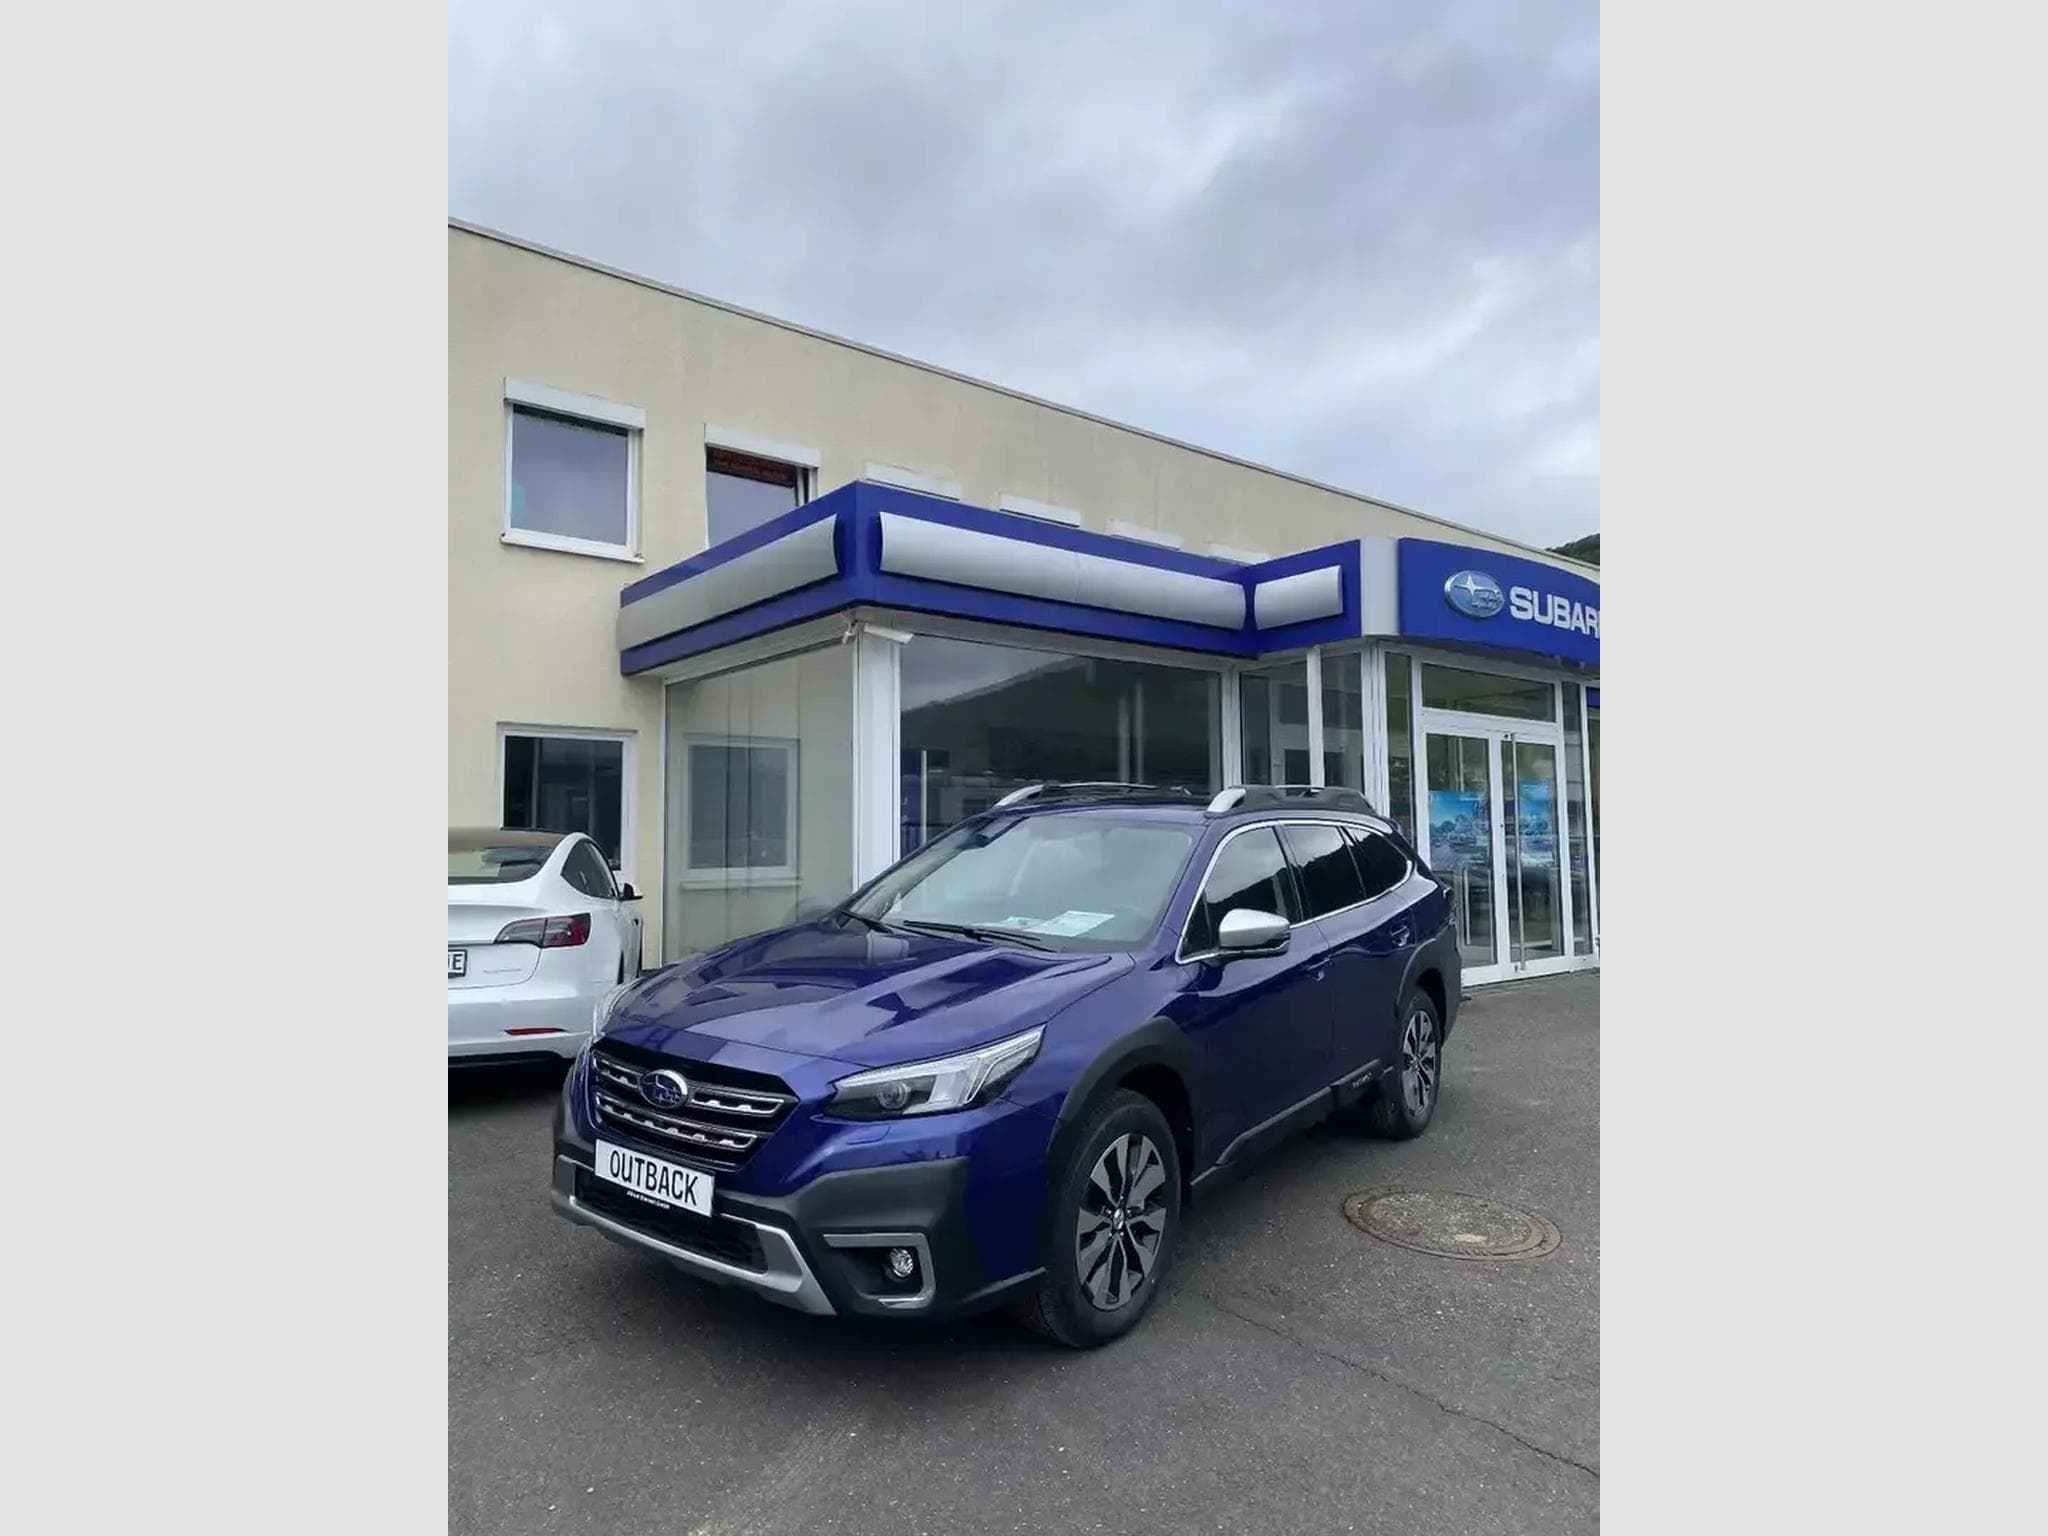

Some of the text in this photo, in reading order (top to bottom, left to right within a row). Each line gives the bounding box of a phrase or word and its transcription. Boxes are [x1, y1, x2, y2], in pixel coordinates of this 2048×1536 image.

[1509, 586, 1600, 639] SUBAR
[448, 953, 463, 971] E
[609, 1150, 698, 1207] OUTBACK
